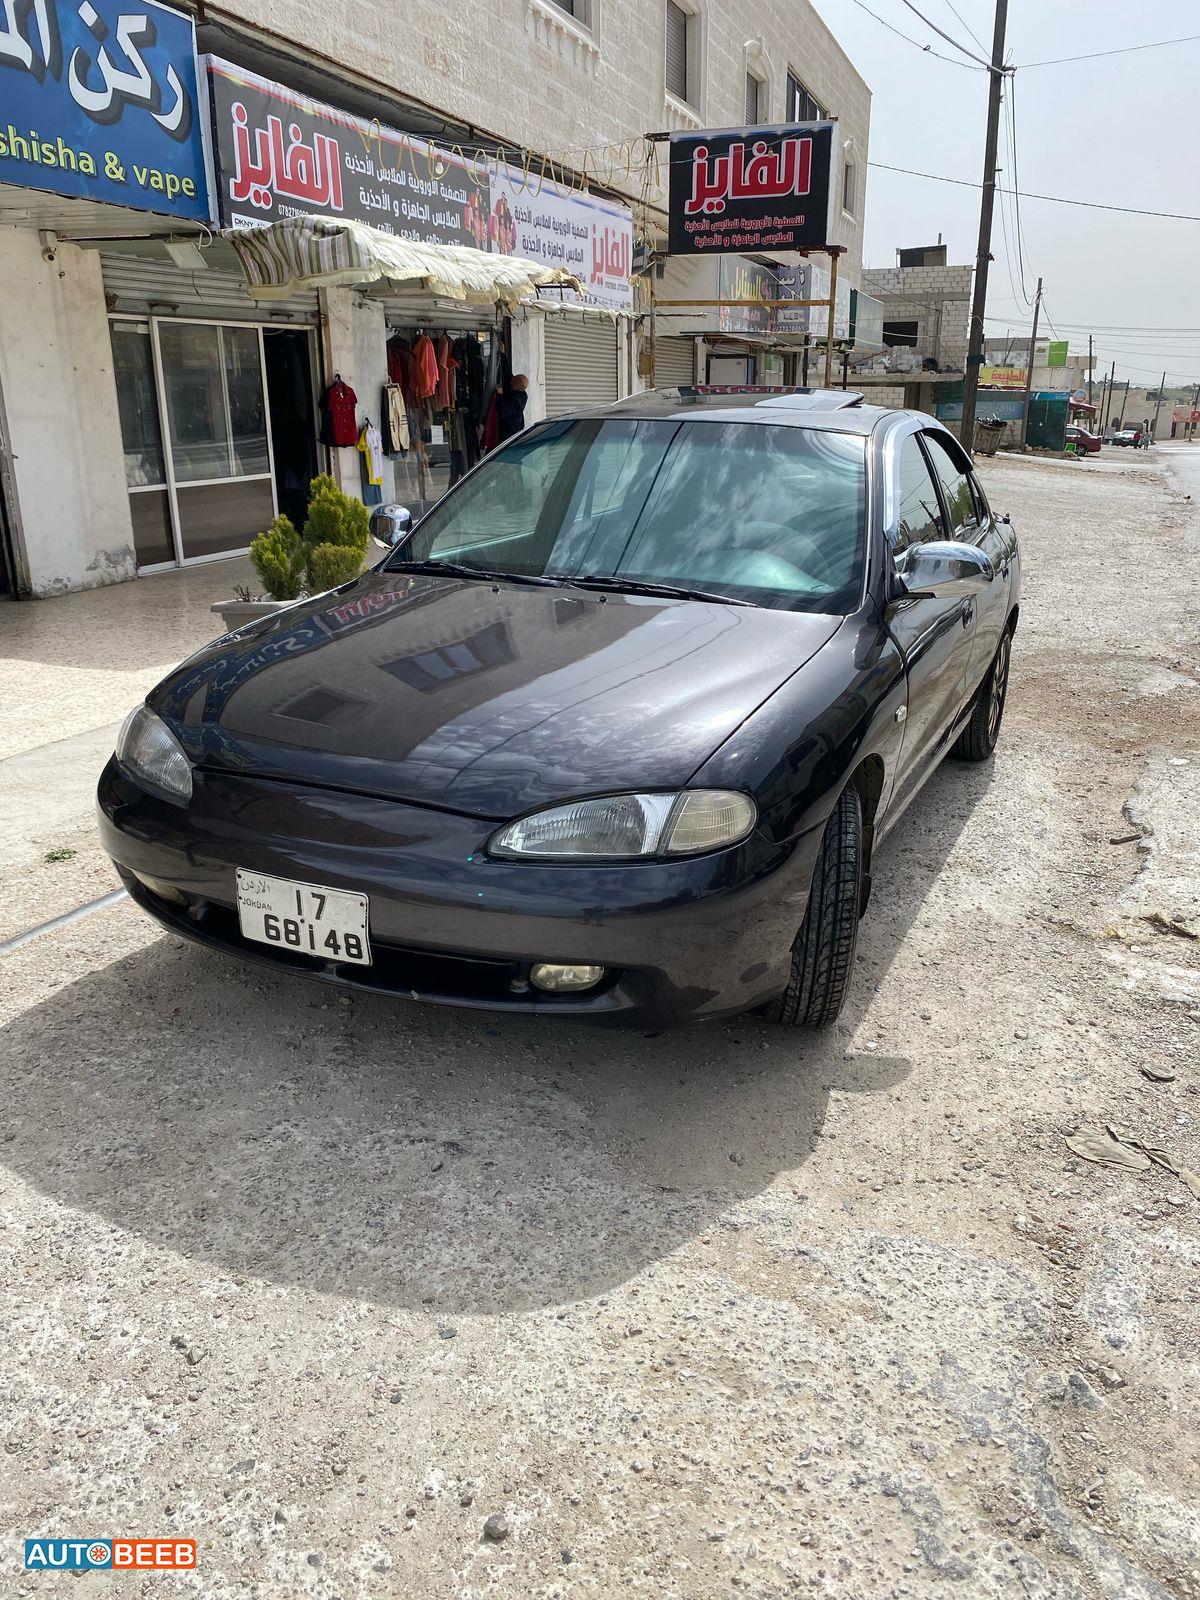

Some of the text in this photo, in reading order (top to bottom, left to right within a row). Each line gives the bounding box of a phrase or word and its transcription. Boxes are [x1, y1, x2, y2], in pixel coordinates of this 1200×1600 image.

[68, 0, 184, 131] ركن
[0, 125, 195, 199] shisha & vape
[230, 102, 343, 211] الفايز
[345, 152, 374, 176] الأحذية
[684, 138, 813, 215] الفايز
[360, 187, 461, 229] الملابس الجاهزة و الأحذية
[685, 218, 711, 233] الأحذية
[591, 223, 630, 286] الفايز
[723, 236, 730, 247] و
[241, 897, 272, 911] JORDAN
[296, 889, 327, 921] 17
[264, 913, 364, 960] 68148
